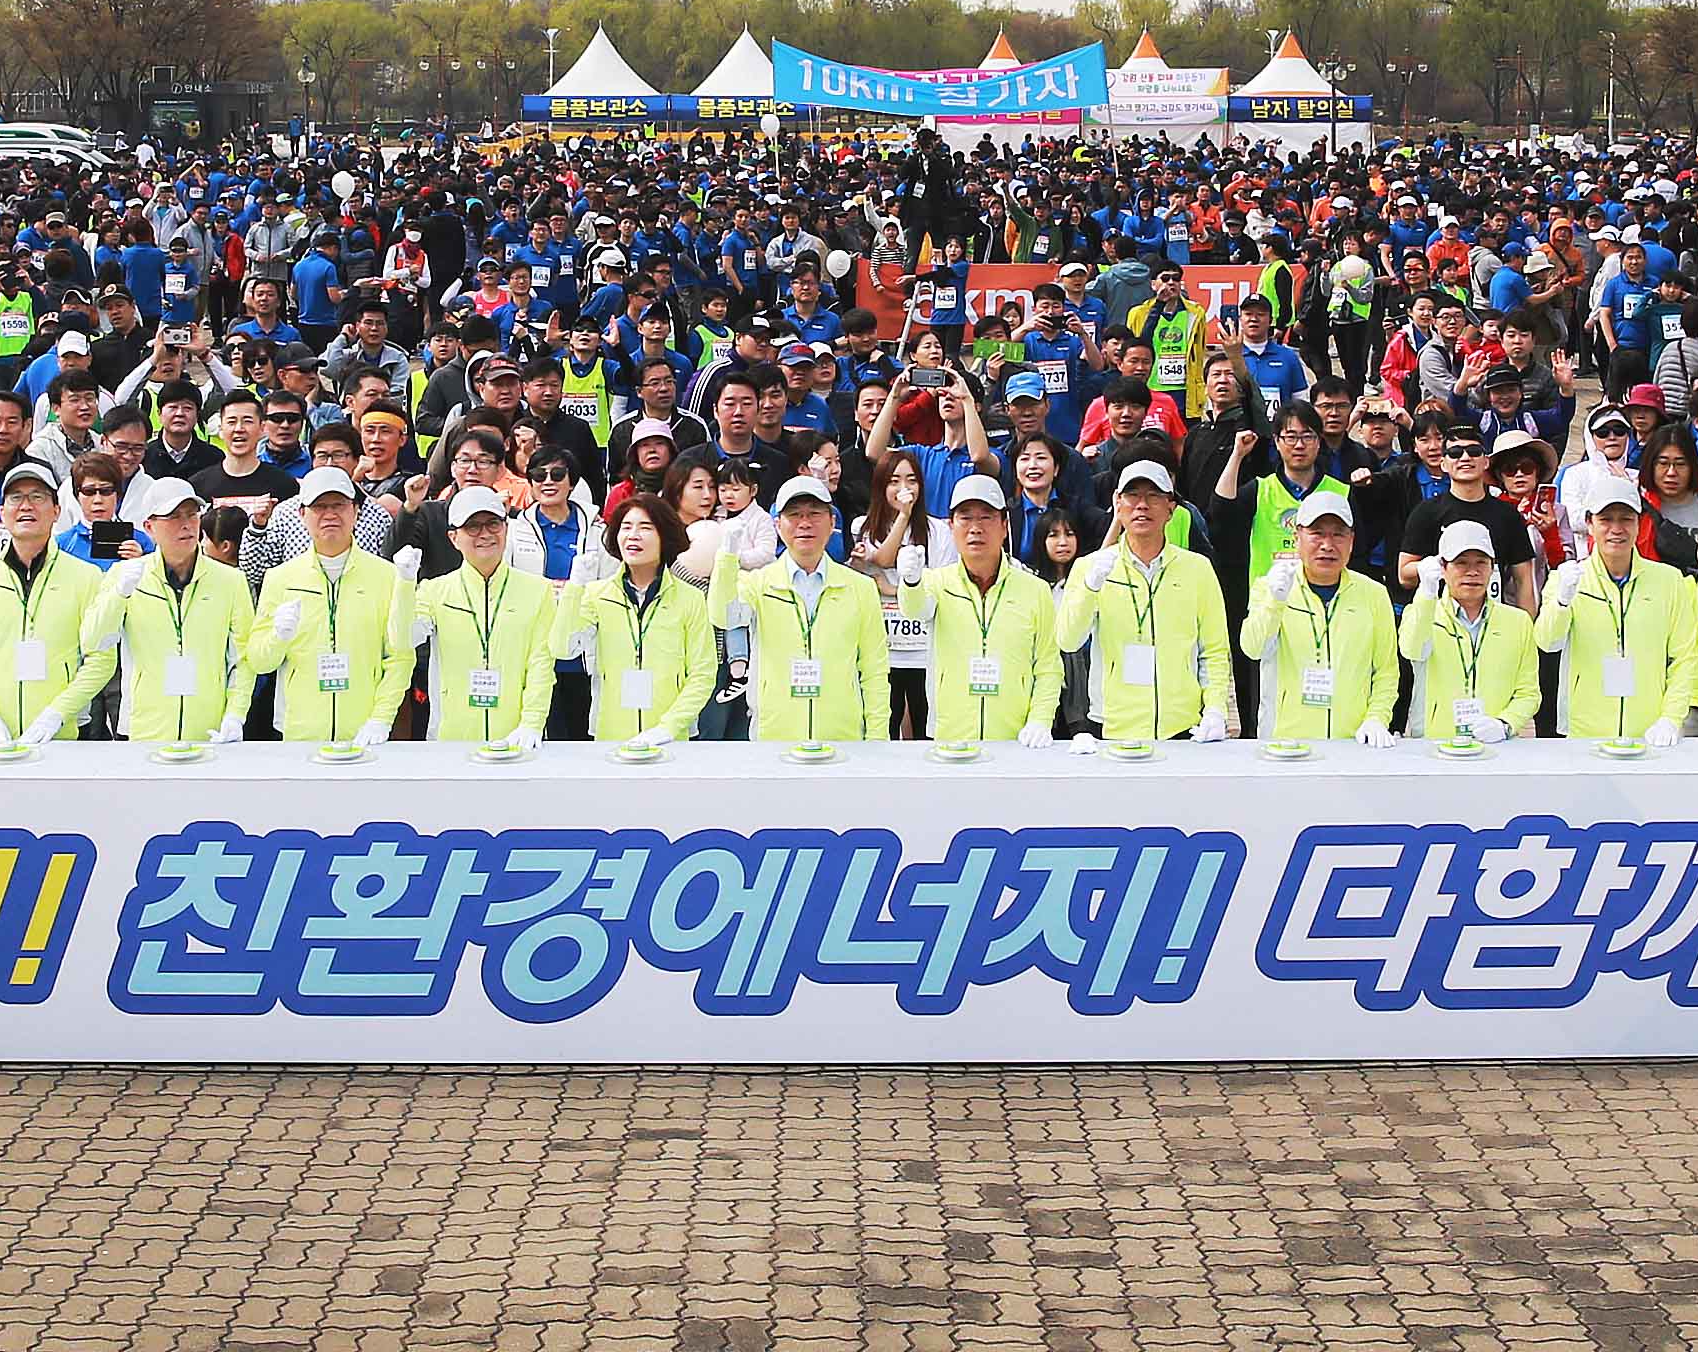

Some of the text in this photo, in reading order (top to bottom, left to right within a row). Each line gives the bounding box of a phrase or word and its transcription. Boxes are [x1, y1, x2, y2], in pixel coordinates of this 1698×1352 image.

[549, 98, 648, 118] 물품보관소
[697, 98, 796, 118] 물품보관소
[1251, 99, 1354, 119] 남자 탈의실
[884, 619, 929, 636] 1788
[125, 838, 1231, 1006] 친환경에너지!
